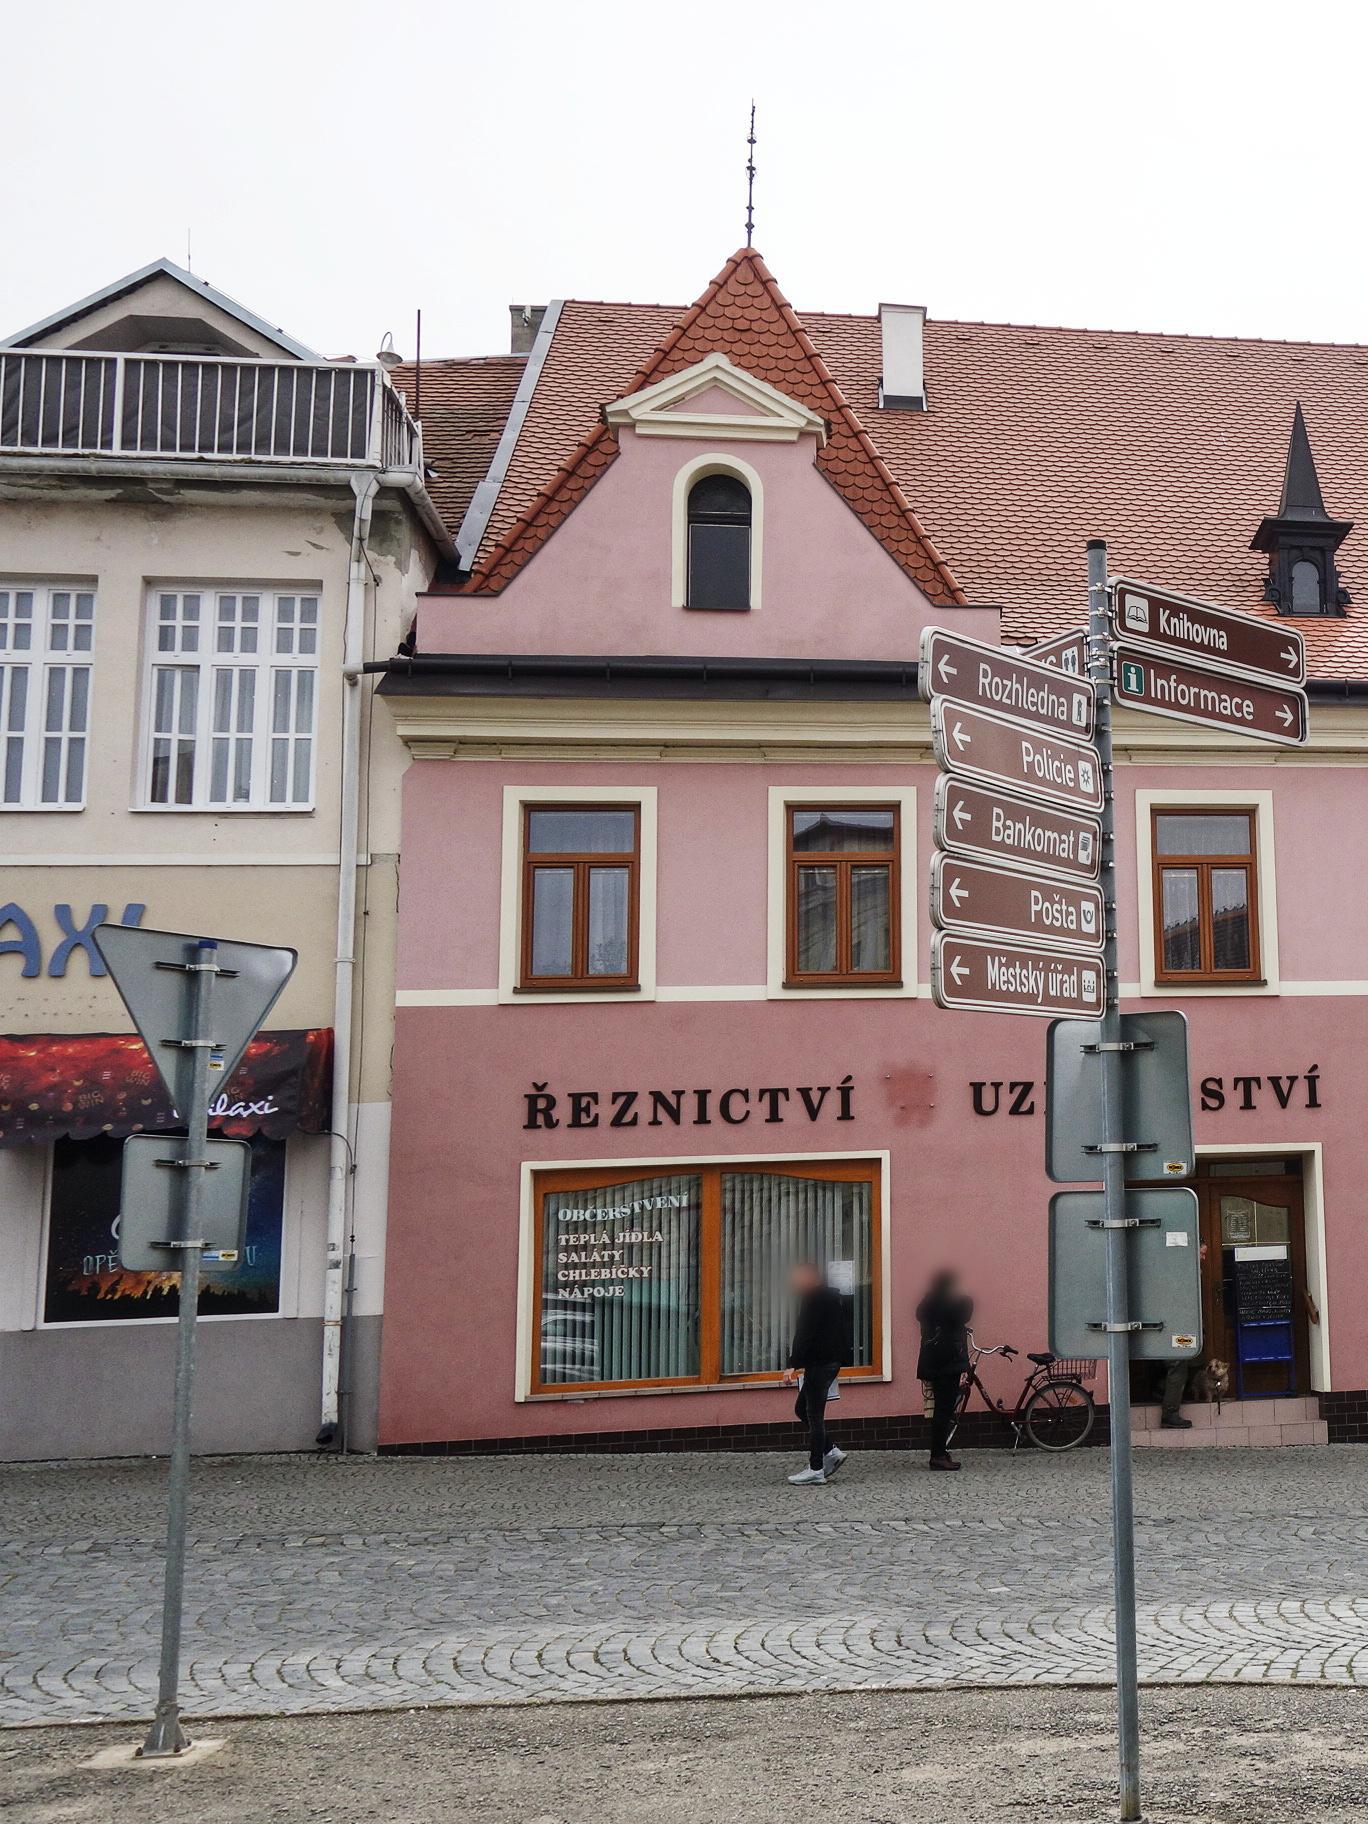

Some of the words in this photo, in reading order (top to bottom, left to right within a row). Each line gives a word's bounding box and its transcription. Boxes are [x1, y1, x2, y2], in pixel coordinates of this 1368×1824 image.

[1159, 607, 1228, 650] Knihovna
[978, 662, 1067, 721] Rozhledna
[1150, 669, 1254, 720] Informace
[1021, 740, 1075, 788] Policie
[991, 807, 1075, 860] Bankomat
[1030, 889, 1077, 930] Pošta
[987, 955, 1045, 1004] Městský
[1049, 963, 1078, 999] úřad
[522, 1075, 855, 1130] ŘEZNICTVÍ
[969, 1063, 1323, 1117] UZSTVÍ
[558, 1192, 689, 1222] OBČERSTVENÍ
[557, 1230, 612, 1246] TEPLÁ
[614, 1229, 664, 1243] JÍDLA
[557, 1248, 624, 1264] SALÁTY
[557, 1265, 653, 1281] CHLEBÍČKY
[557, 1284, 626, 1299] NÁPOJE
